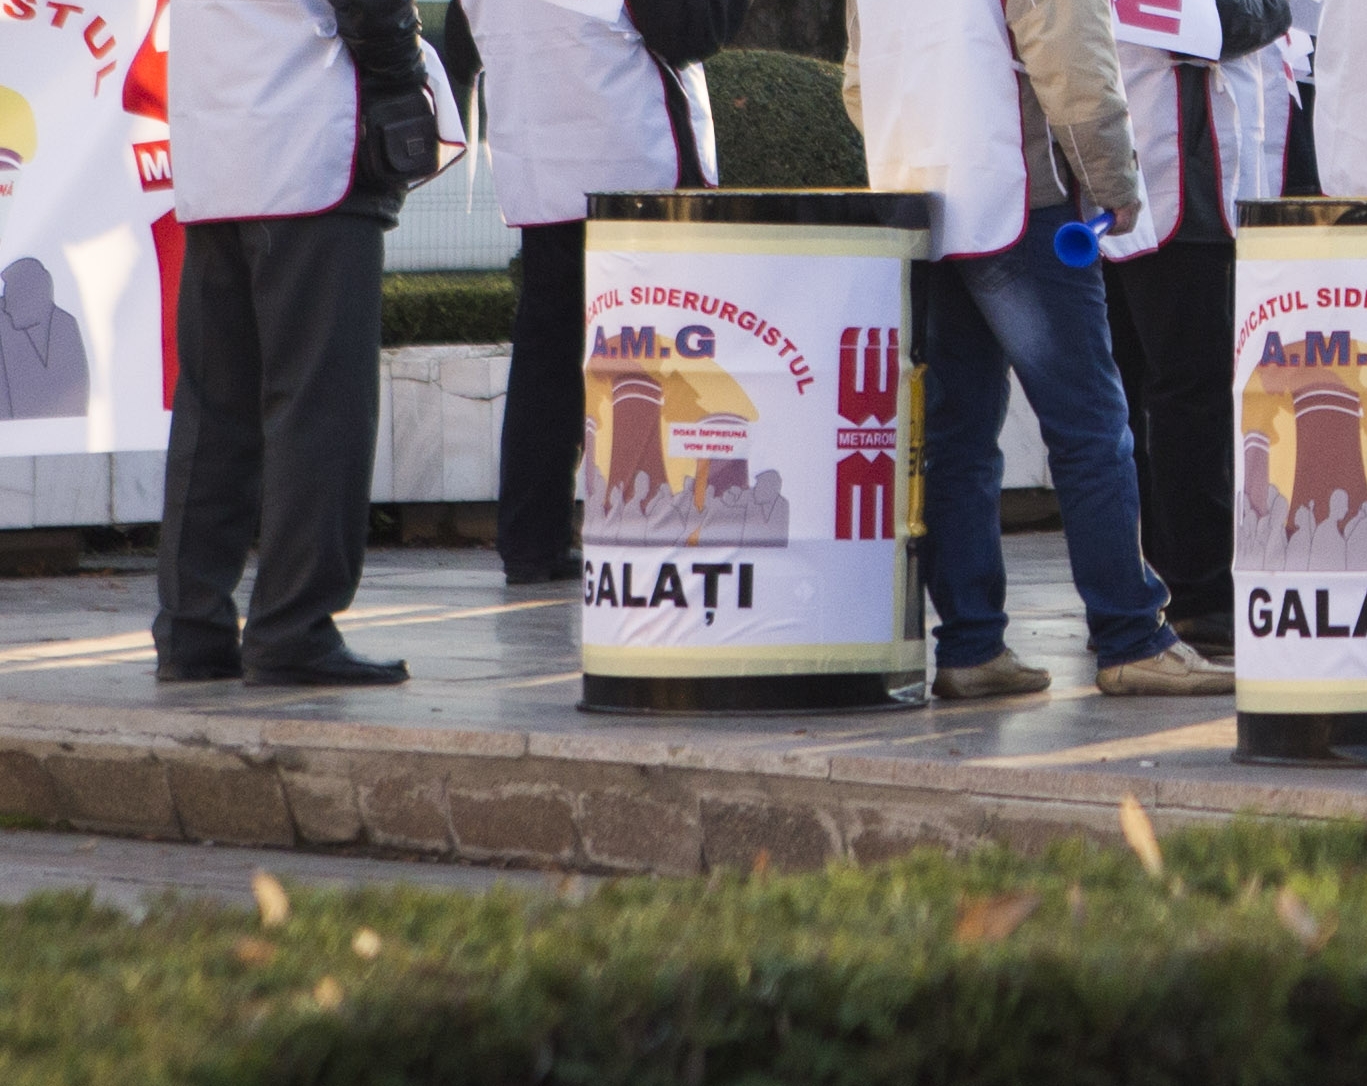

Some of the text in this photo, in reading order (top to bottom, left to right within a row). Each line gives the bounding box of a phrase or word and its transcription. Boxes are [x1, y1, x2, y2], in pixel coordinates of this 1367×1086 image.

[591, 324, 717, 360] A.M.G
[630, 286, 815, 395] SIDERURGISTUL
[584, 559, 754, 627] GALAȚI
